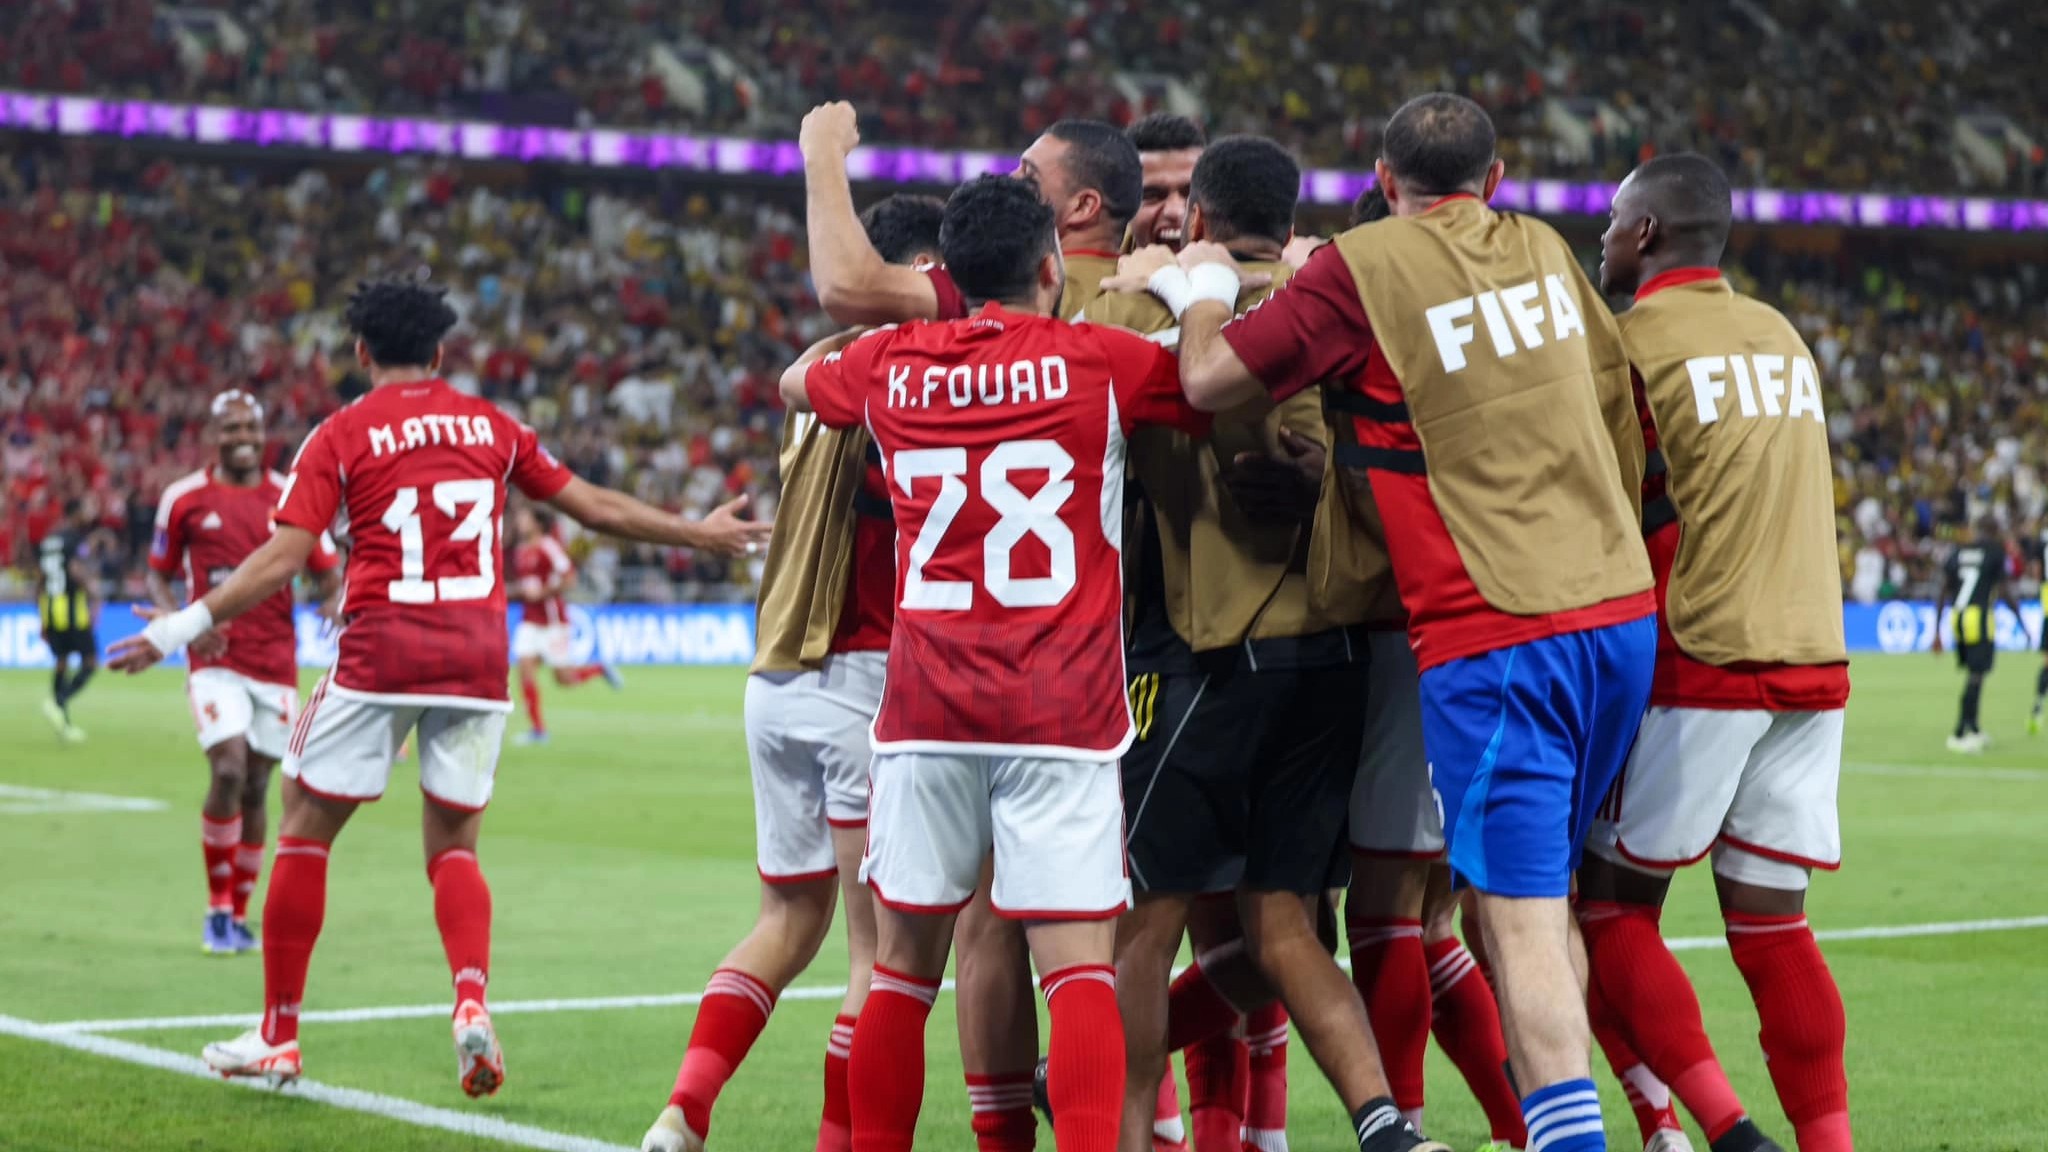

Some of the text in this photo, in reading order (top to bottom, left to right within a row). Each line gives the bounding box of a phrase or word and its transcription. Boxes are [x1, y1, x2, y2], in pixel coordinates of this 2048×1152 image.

[1425, 273, 1585, 374] FIFA
[887, 355, 1069, 409] K.FOUAD
[1685, 353, 1826, 424] FIFA
[369, 414, 495, 457] M.ATTIA
[382, 478, 496, 604] 13
[893, 440, 1077, 610] 28
[596, 612, 756, 664] WANDA
